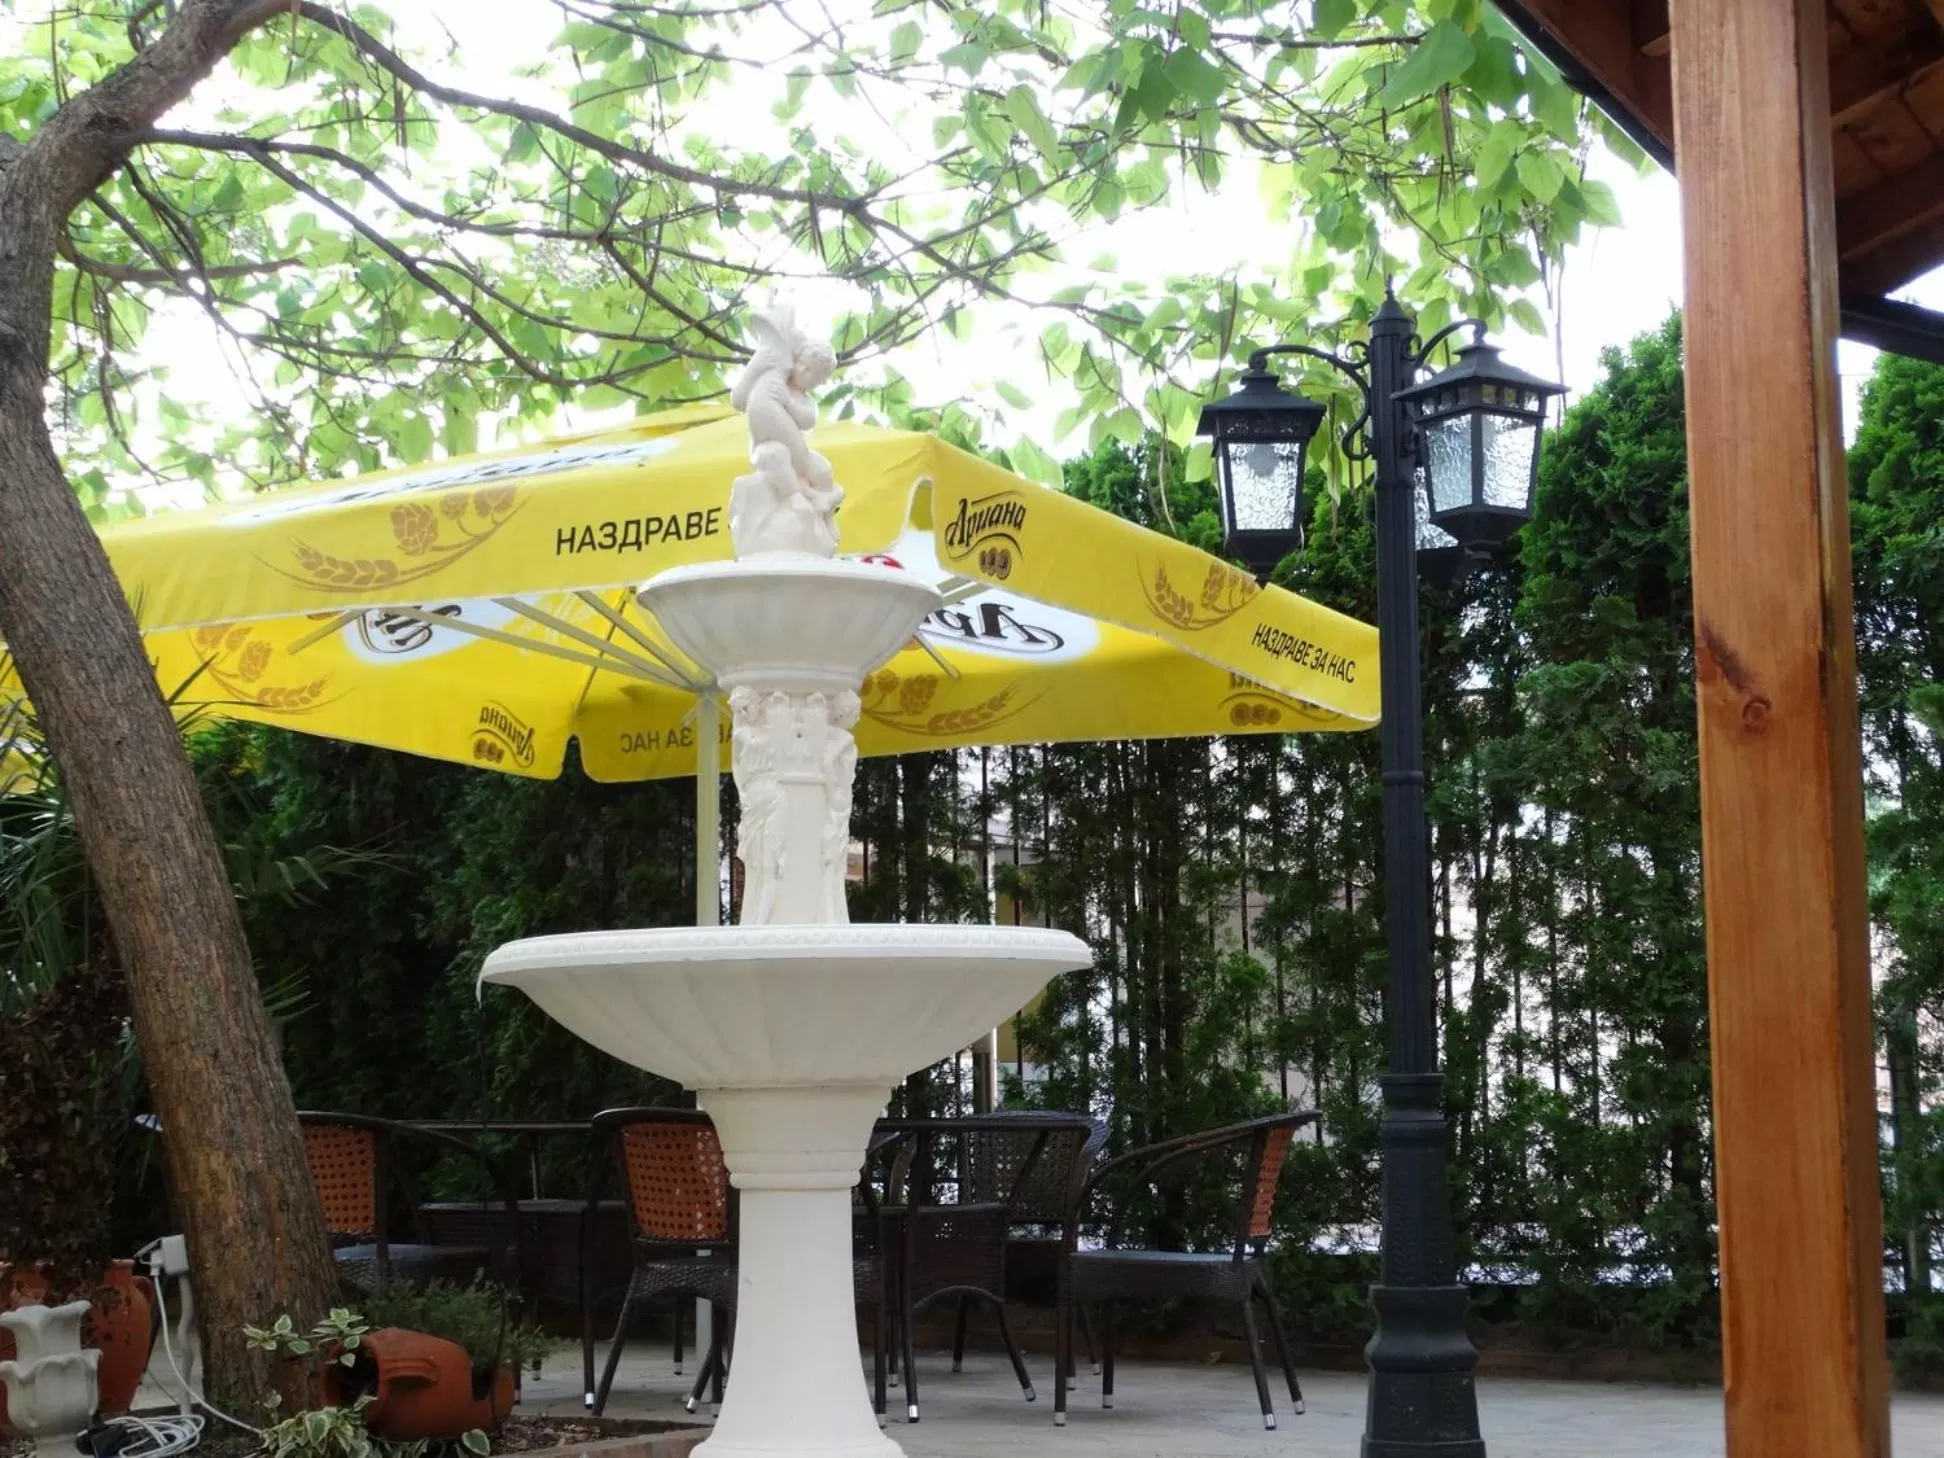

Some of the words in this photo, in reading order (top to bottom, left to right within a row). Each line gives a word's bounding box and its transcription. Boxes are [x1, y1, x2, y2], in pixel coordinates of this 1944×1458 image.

[555, 506, 723, 556] НАЗДРАВЕ
[945, 497, 1027, 548] Ариана
[1251, 623, 1314, 667] НАЗДРАВЕ
[1310, 647, 1329, 674] ЗА
[1326, 654, 1357, 684] НАС
